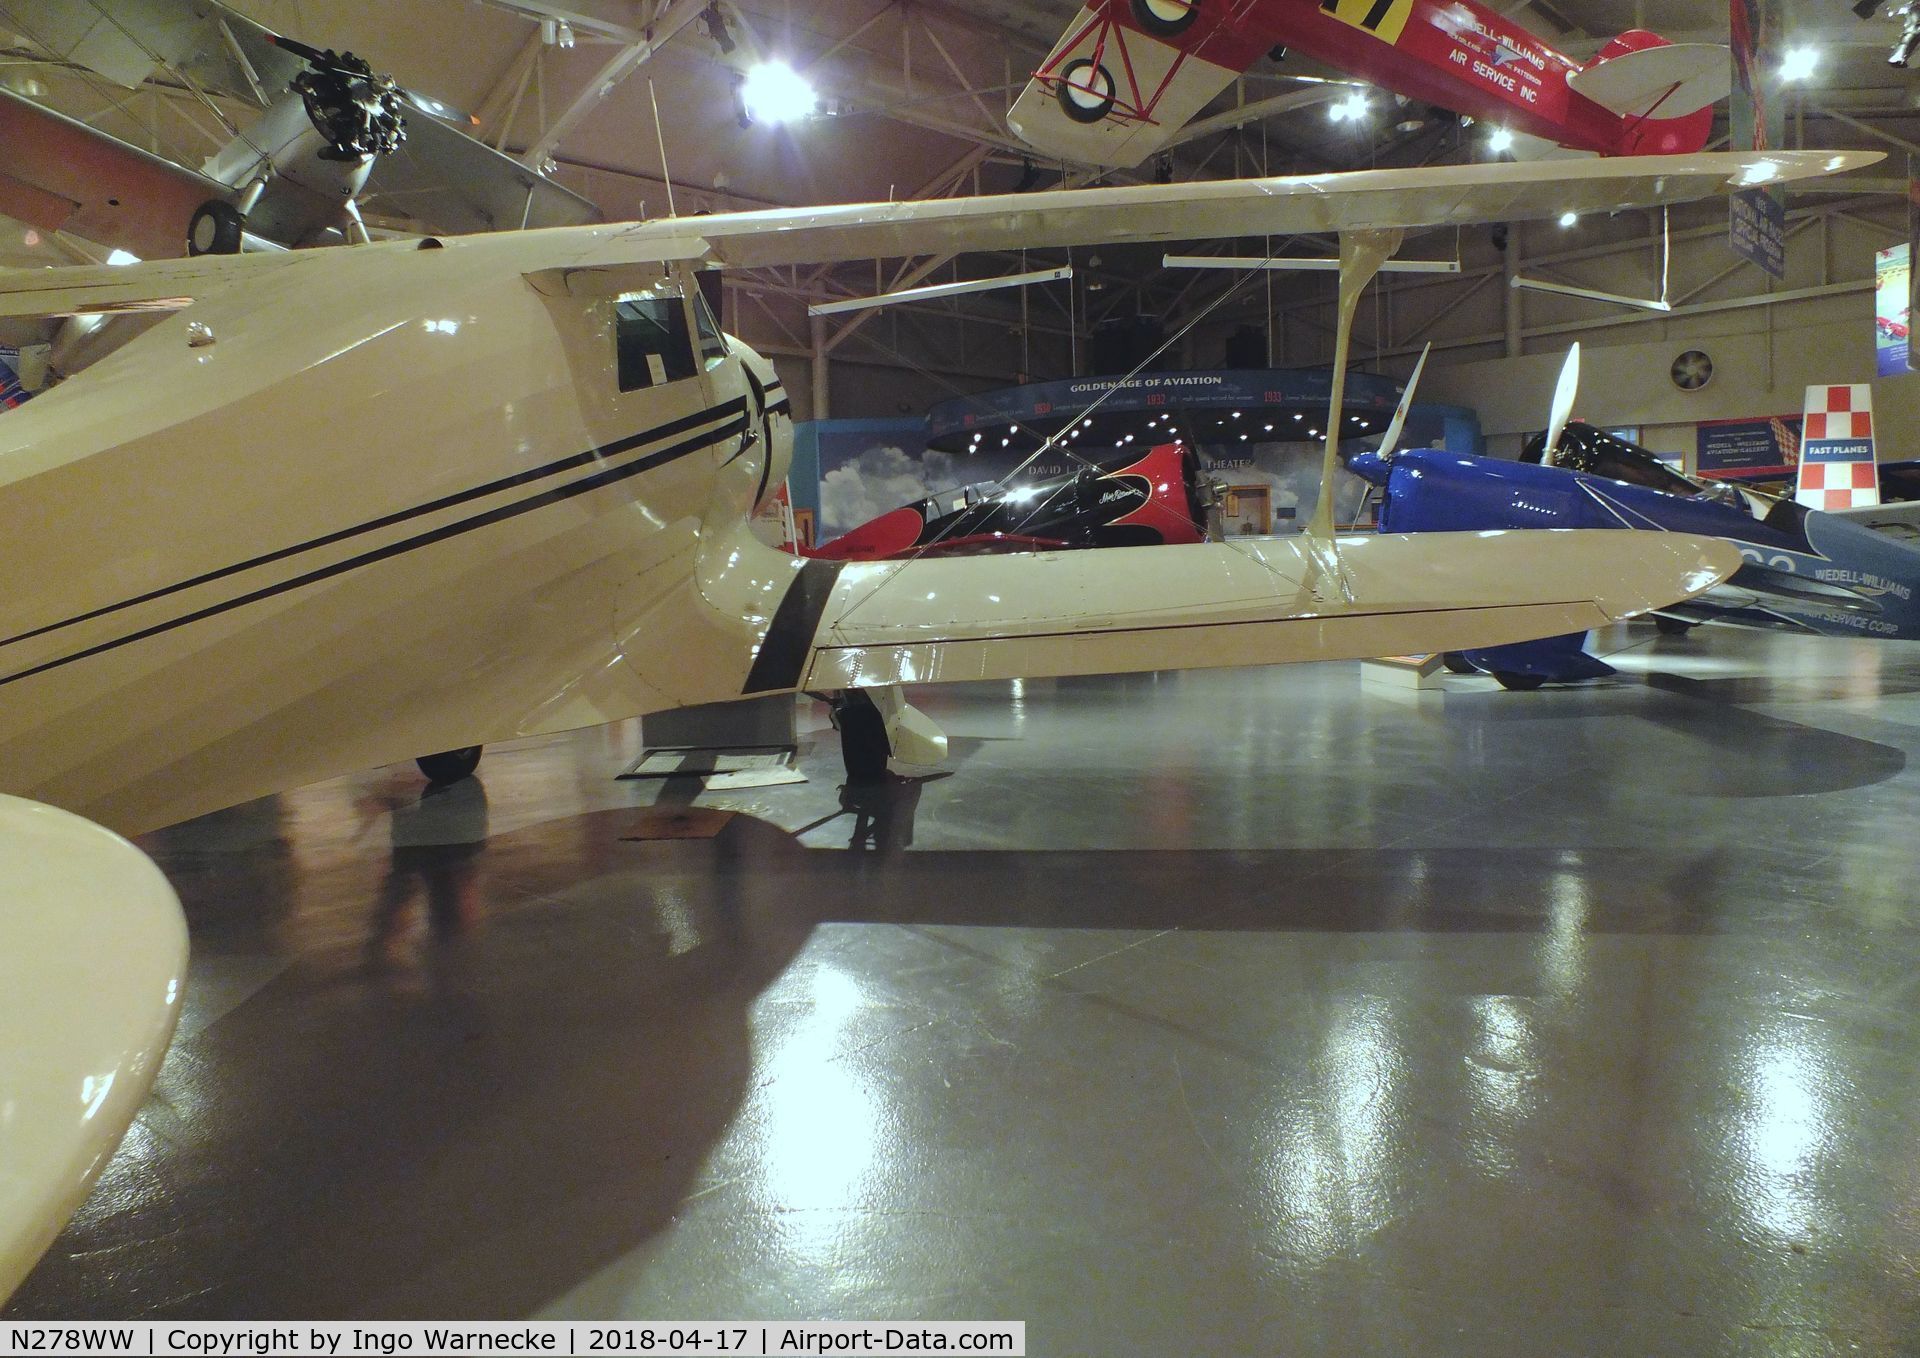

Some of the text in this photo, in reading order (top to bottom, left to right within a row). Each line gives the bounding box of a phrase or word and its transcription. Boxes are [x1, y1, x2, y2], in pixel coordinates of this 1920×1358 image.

[1449, 48, 1468, 66] AIR
[1472, 60, 1516, 92] SERVICE
[1070, 376, 1222, 393] GOLDEN AGE OF AVIATION
[1146, 393, 1166, 405] 1932
[1809, 445, 1869, 455] FAST PLANES
[1028, 465, 1061, 475] DAVID
[1815, 569, 1911, 600] WEDELL-WILLIAMS
